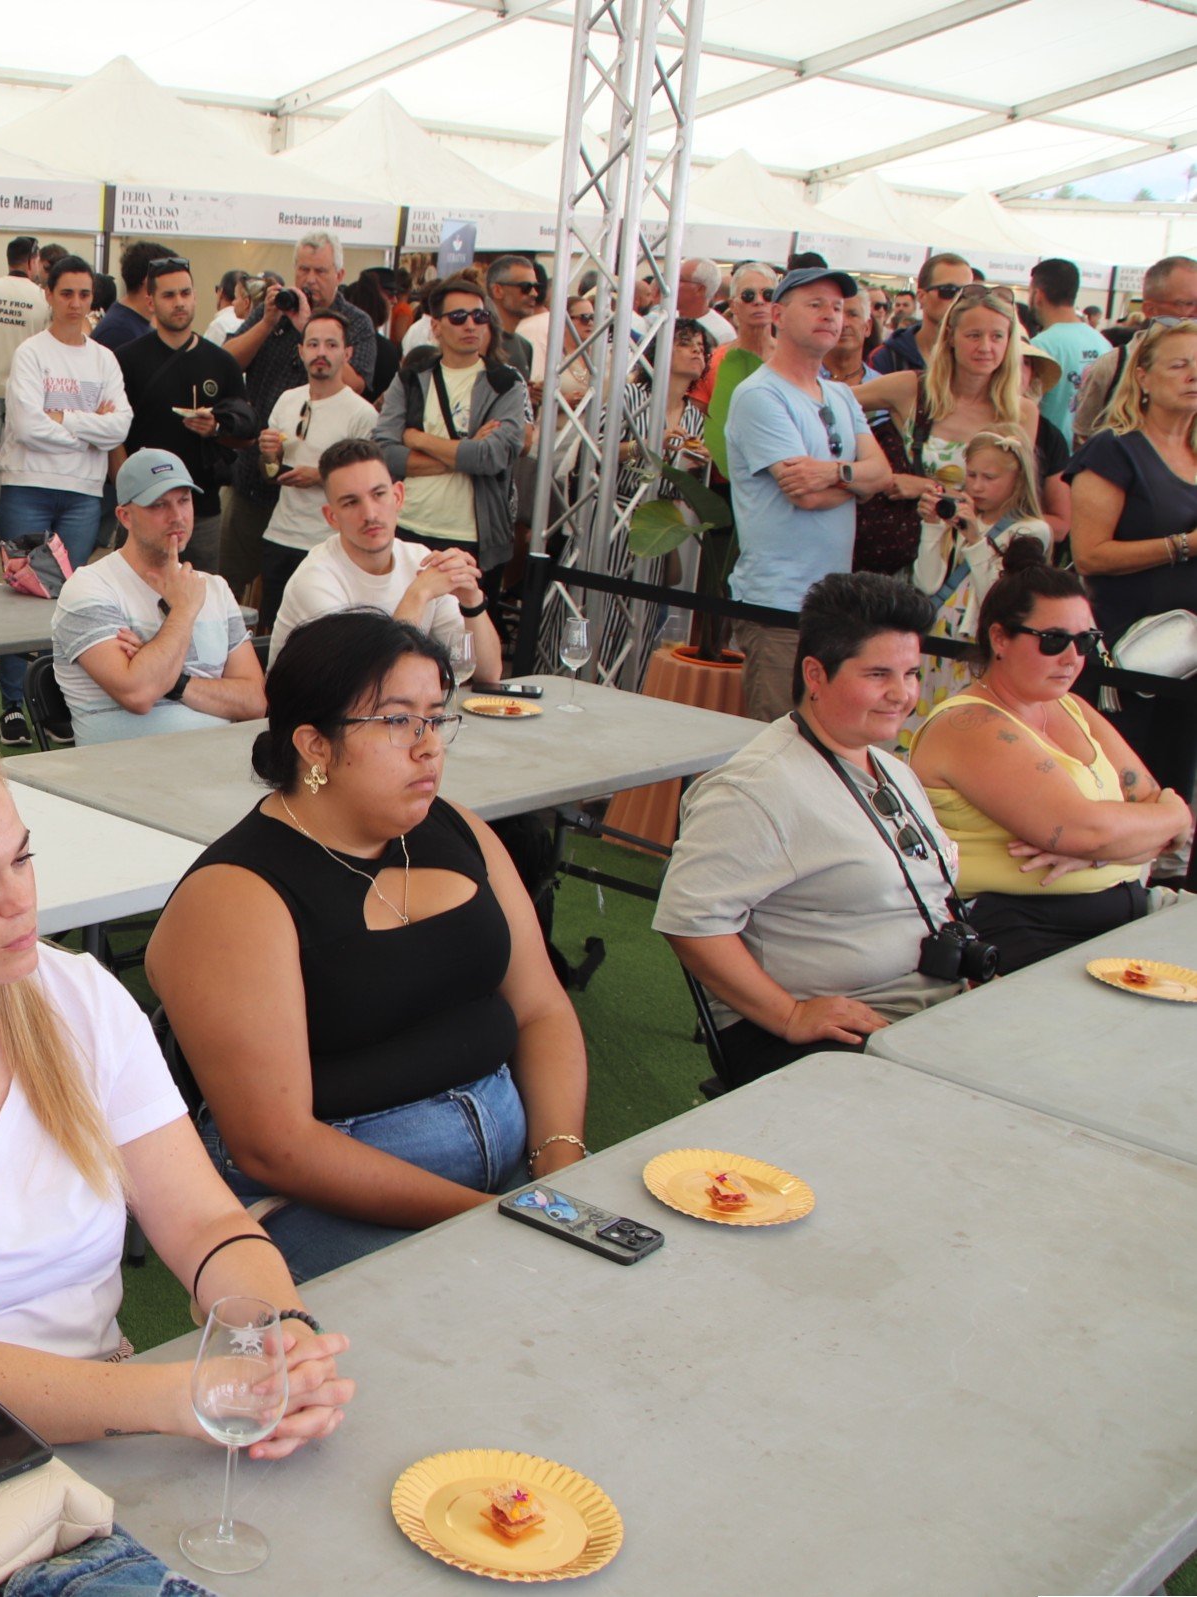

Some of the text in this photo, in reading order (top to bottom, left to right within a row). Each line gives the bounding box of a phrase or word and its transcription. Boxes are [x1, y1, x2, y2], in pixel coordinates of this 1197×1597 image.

[122, 191, 152, 202] FERIA
[13, 196, 53, 211] Mamud
[122, 205, 179, 218] DEL QUESO
[145, 219, 179, 231] CABRA
[278, 212, 363, 229] Restaurante Mamud
[10, 300, 33, 310] FROM
[0, 308, 22, 317] PARIS
[4, 712, 25, 724] PUMA
